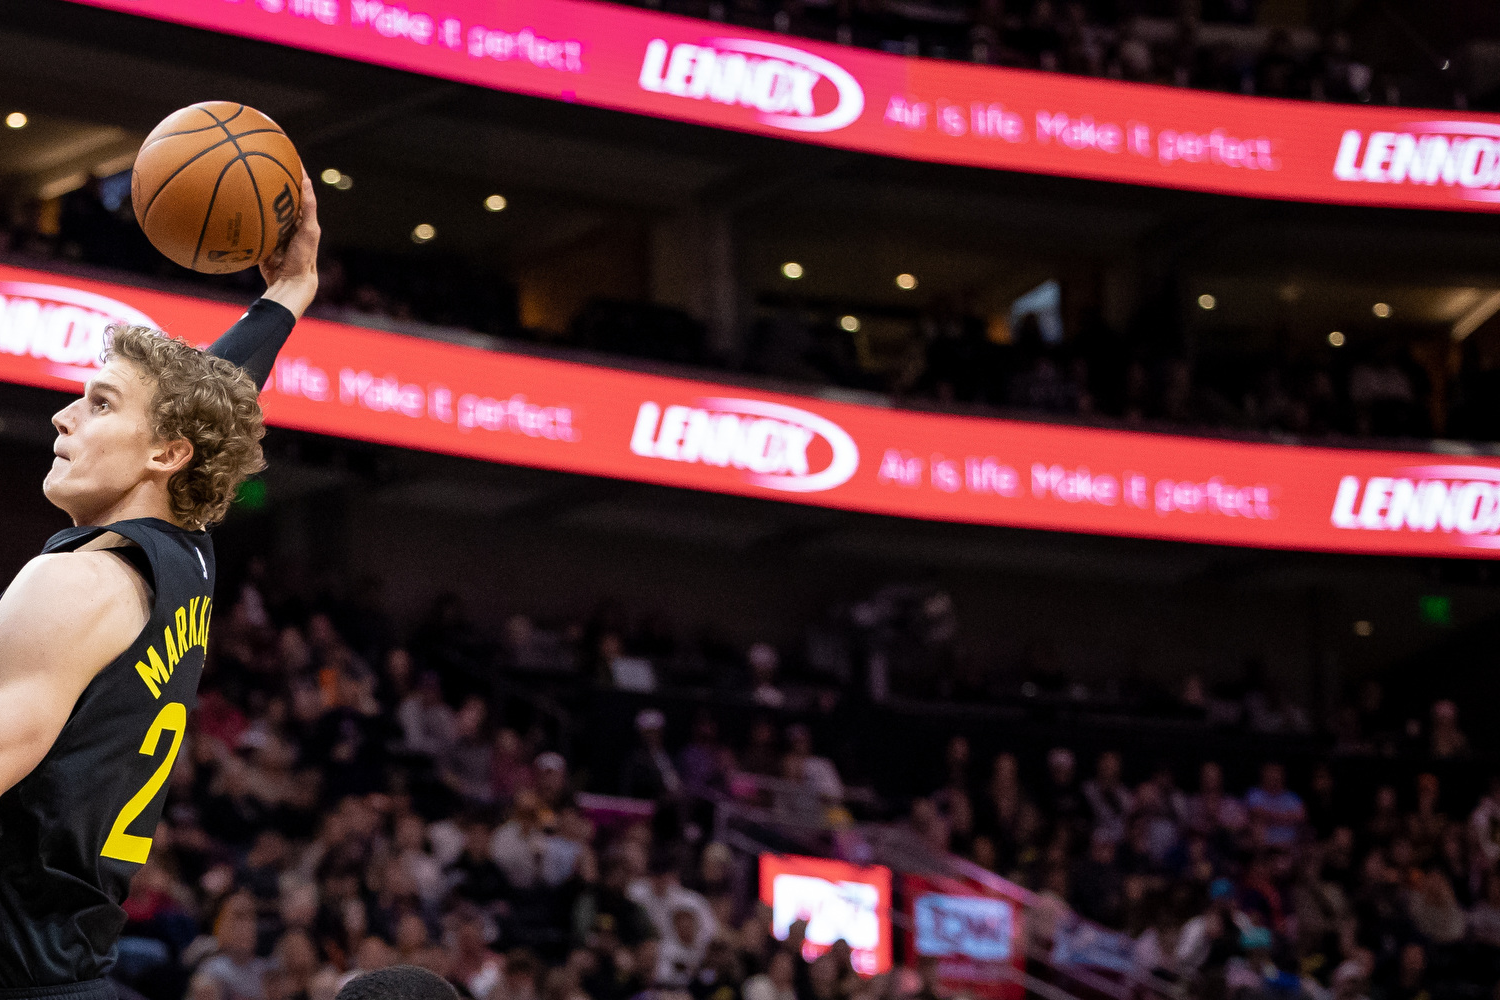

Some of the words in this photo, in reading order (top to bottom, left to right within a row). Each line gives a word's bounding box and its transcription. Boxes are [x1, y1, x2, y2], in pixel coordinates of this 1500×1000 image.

[638, 38, 820, 118] LENNOX
[630, 400, 814, 477] LENNOX
[100, 702, 187, 864] 2
